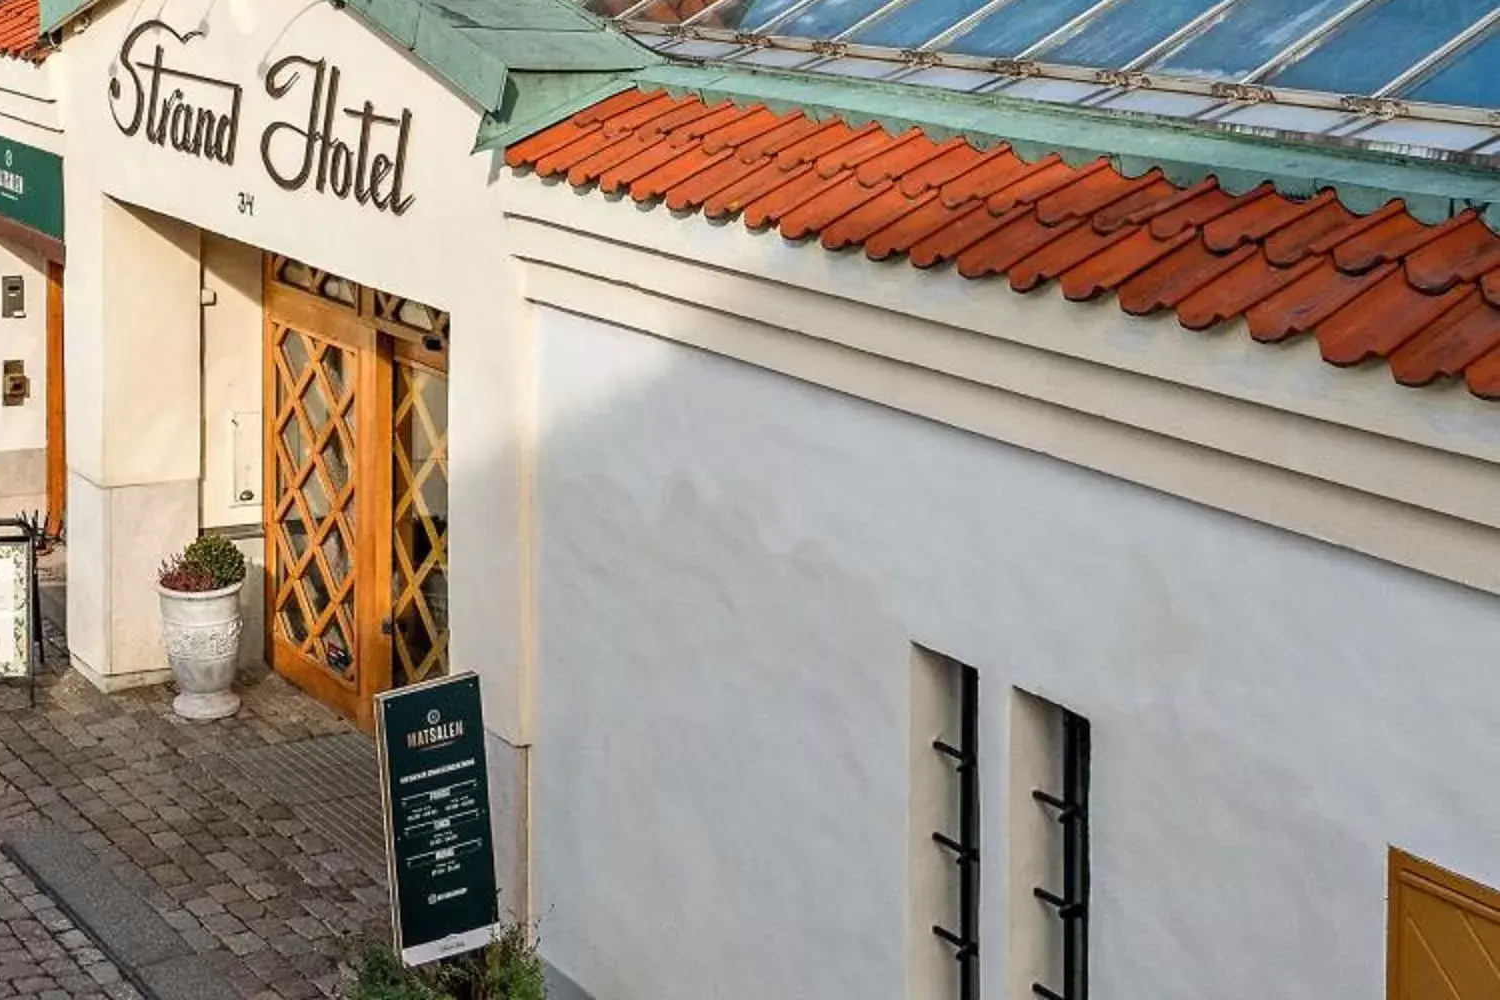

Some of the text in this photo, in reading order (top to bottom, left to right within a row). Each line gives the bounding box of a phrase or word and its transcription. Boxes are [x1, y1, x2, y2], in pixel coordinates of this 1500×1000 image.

[108, 19, 416, 217] Strand Hotel
[238, 192, 255, 216] 34
[405, 719, 464, 749] MATSALEN
